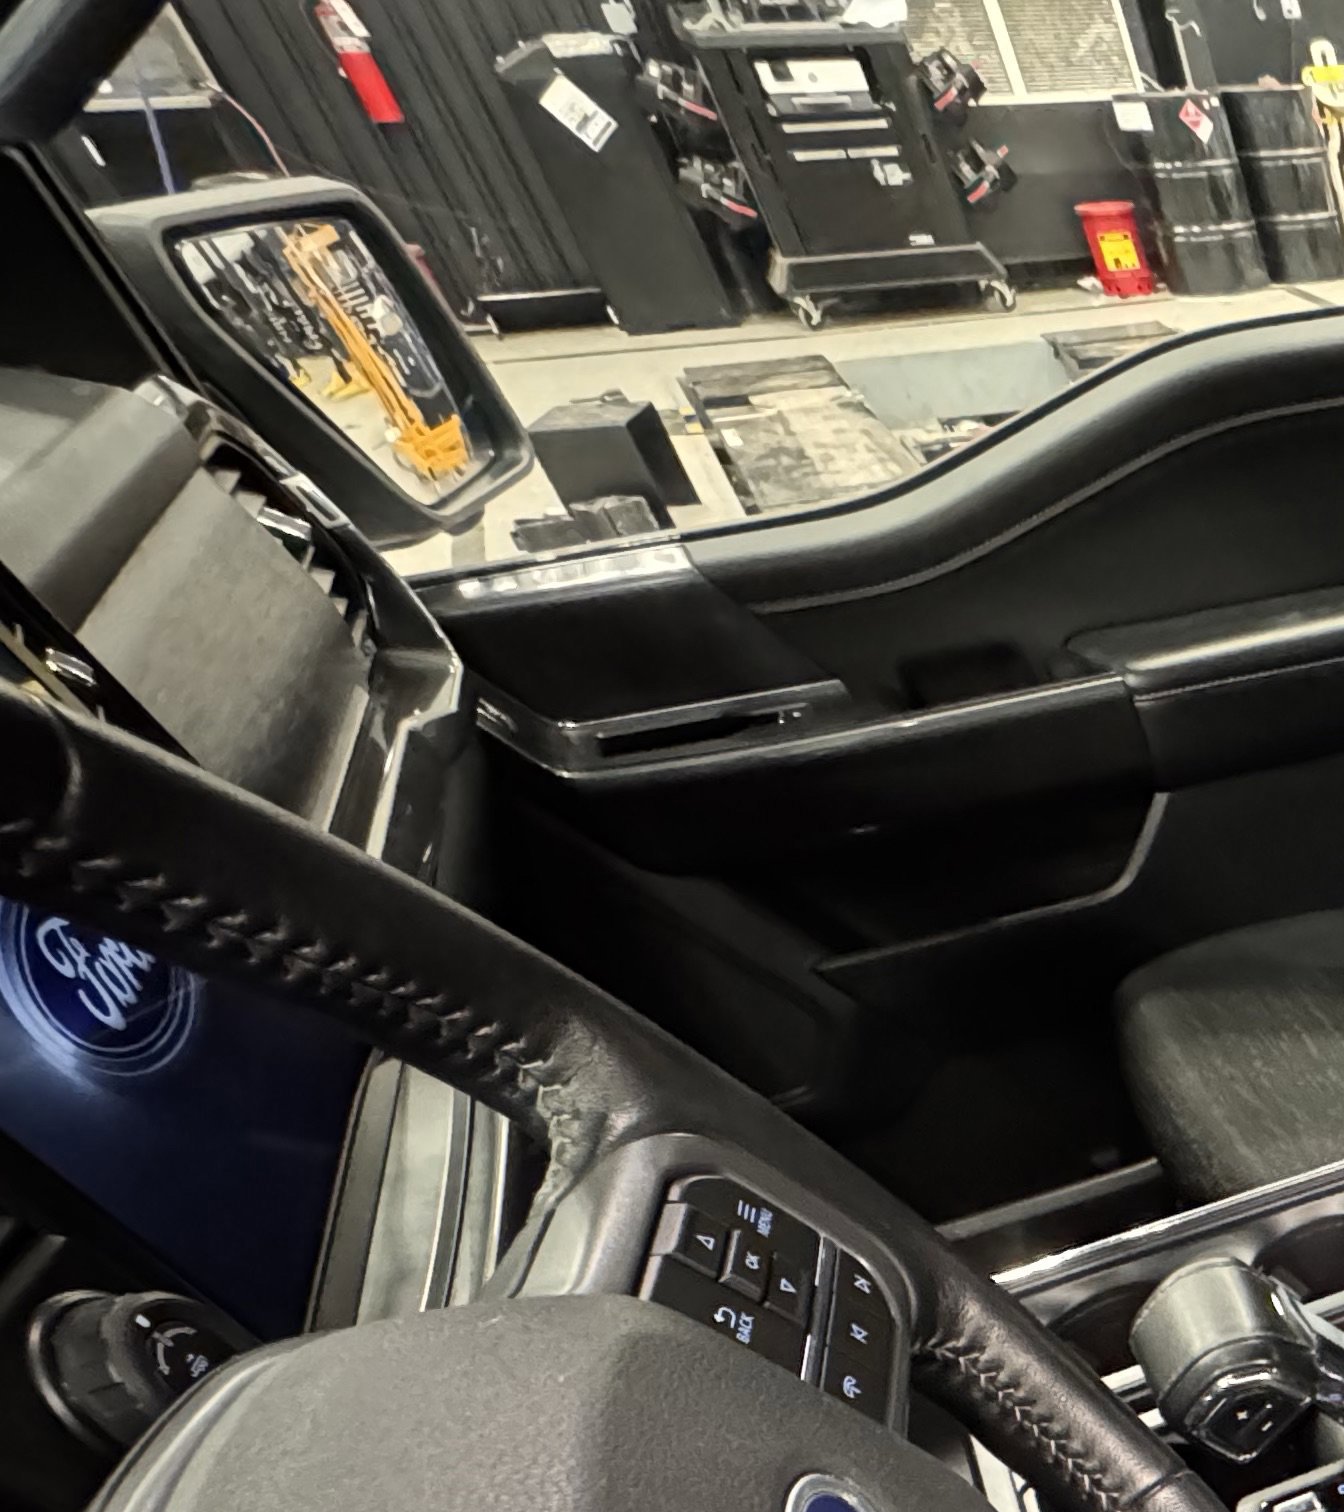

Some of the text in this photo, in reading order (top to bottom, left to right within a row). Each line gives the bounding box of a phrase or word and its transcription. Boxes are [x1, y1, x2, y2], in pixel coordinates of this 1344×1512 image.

[756, 1207, 773, 1238] MENU
[745, 1251, 760, 1270] OK
[736, 1312, 755, 1345] BACK
